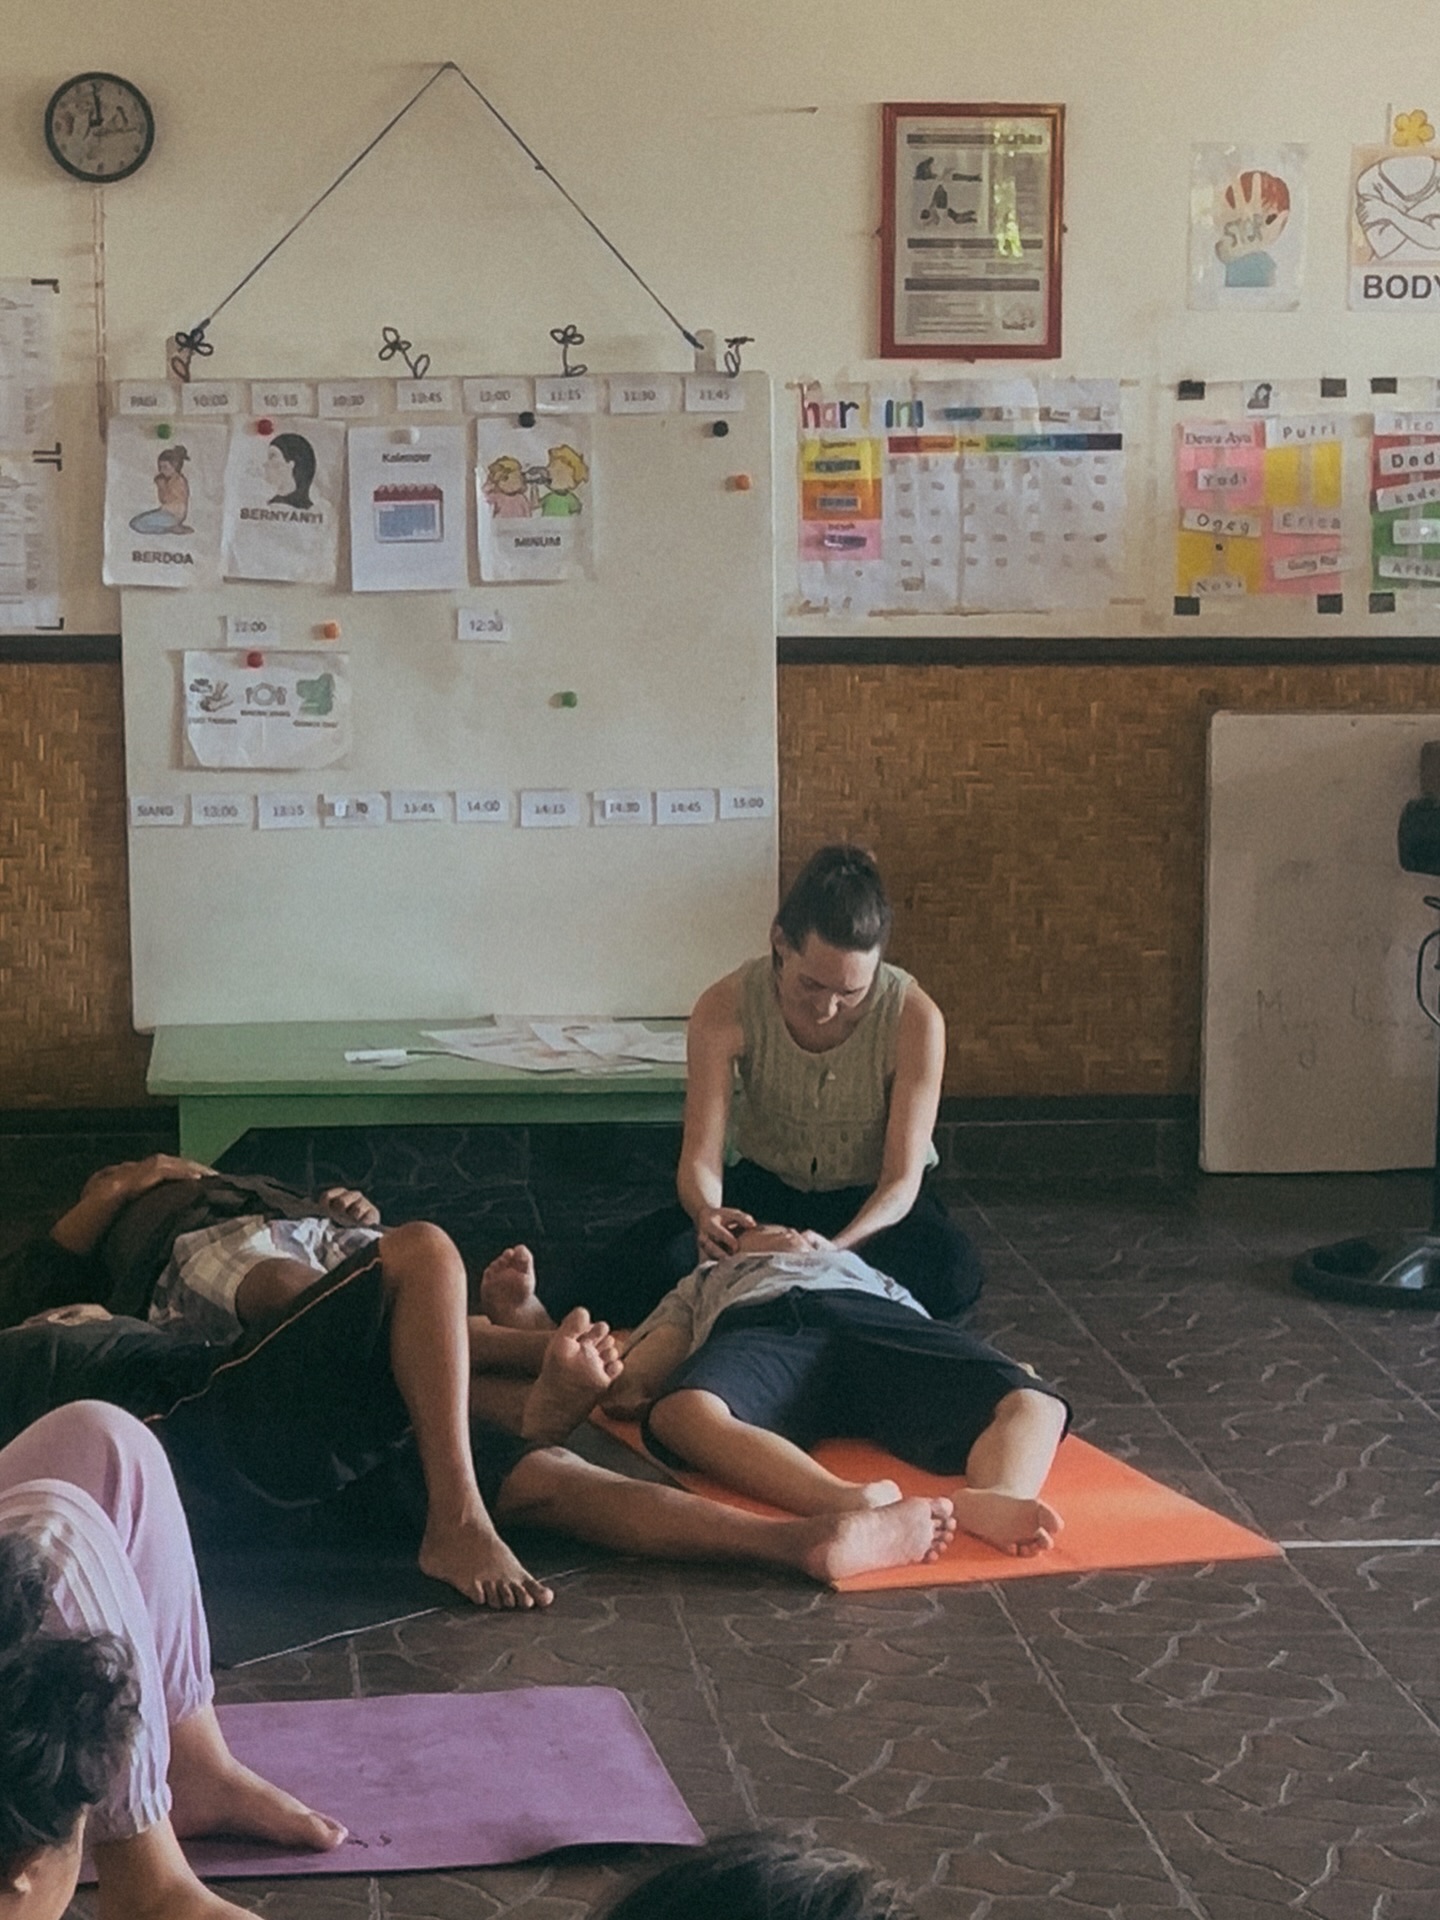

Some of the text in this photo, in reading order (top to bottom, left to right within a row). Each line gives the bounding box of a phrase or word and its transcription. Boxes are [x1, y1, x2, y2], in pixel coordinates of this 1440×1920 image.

[192, 394, 229, 408] 10:00
[263, 394, 299, 407] 10:15
[239, 507, 324, 525] BERNYANYI
[131, 550, 194, 566] BERDOA
[469, 619, 503, 633] 12:30
[466, 799, 501, 813] 14:00
